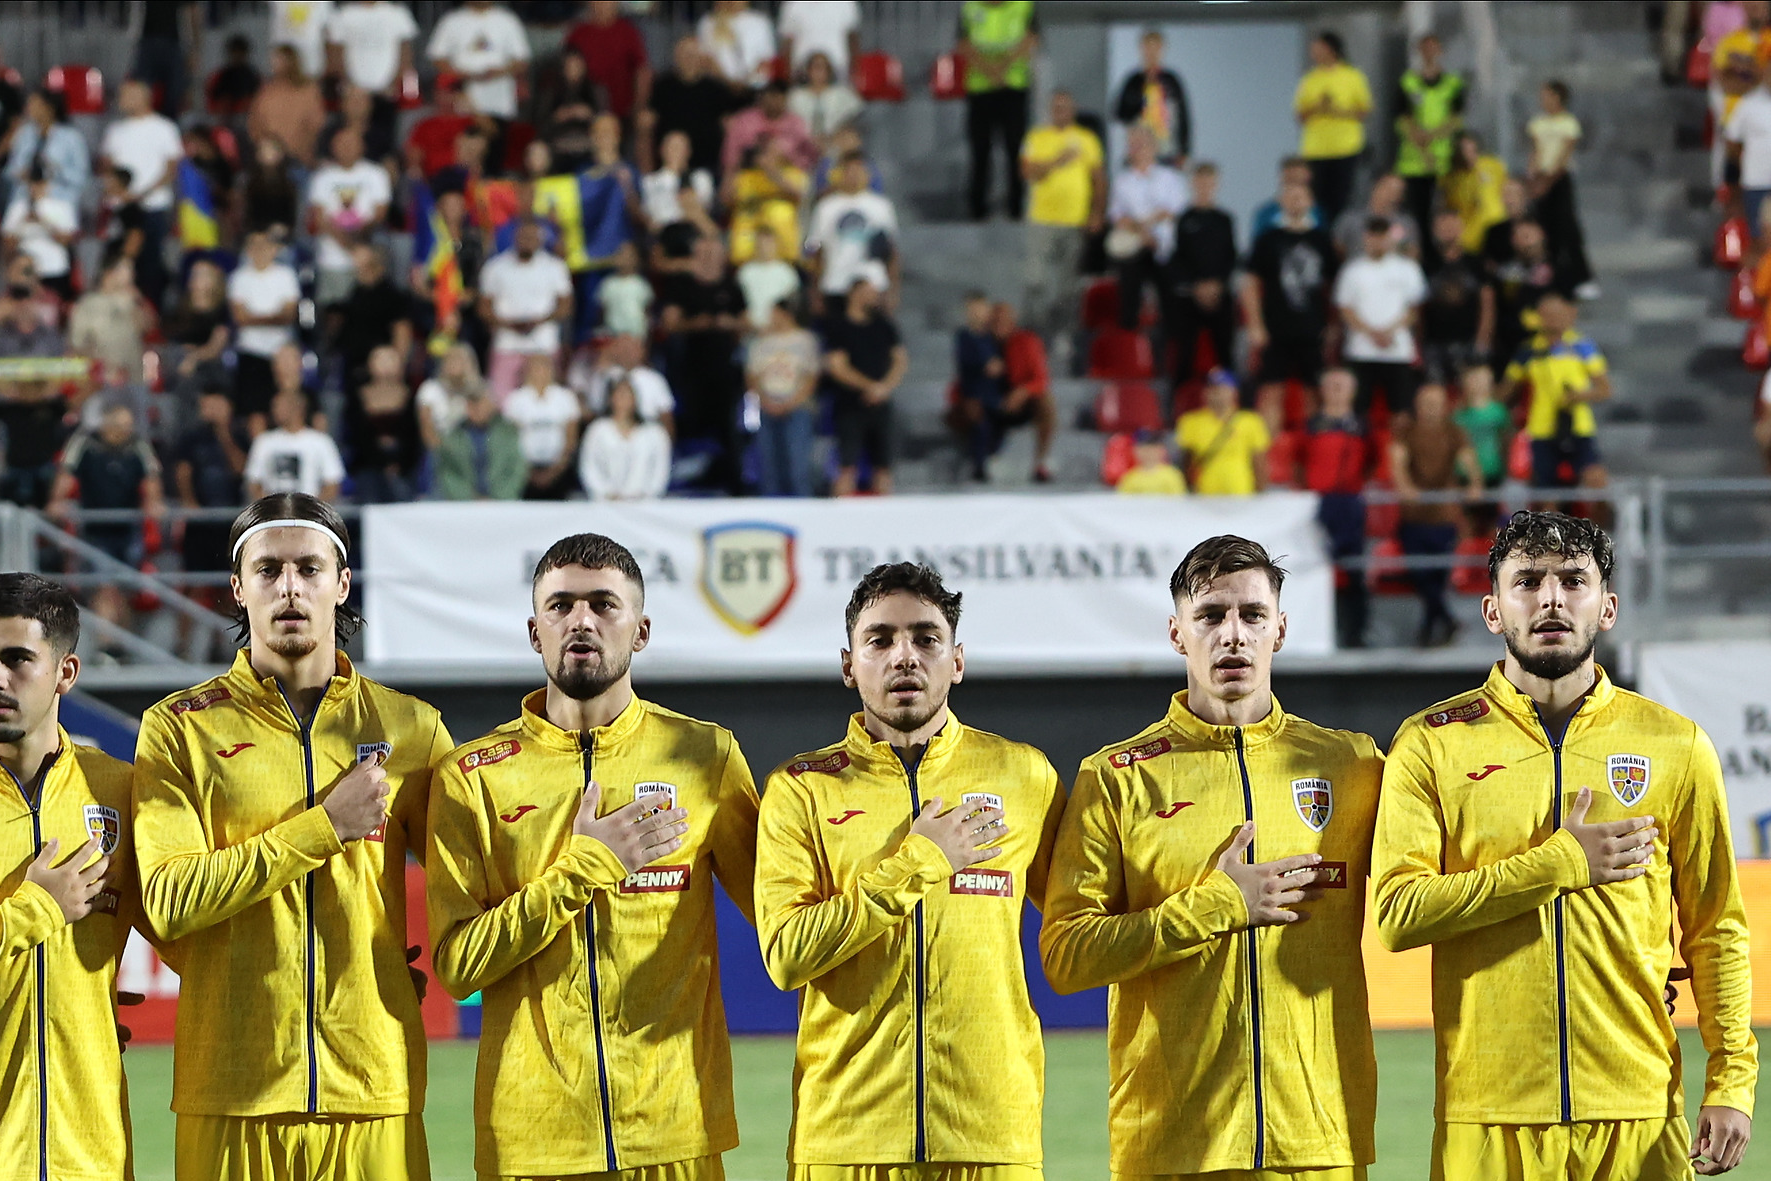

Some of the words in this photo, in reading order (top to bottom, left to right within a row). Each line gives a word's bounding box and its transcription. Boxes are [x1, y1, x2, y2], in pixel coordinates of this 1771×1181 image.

[721, 548, 782, 583] BT
[1448, 703, 1480, 717] casa
[480, 742, 512, 758] casa
[1612, 756, 1646, 766] ROMÂNIA
[1296, 780, 1328, 791] ROMÂNIA
[87, 806, 116, 819] ROMÂNIA
